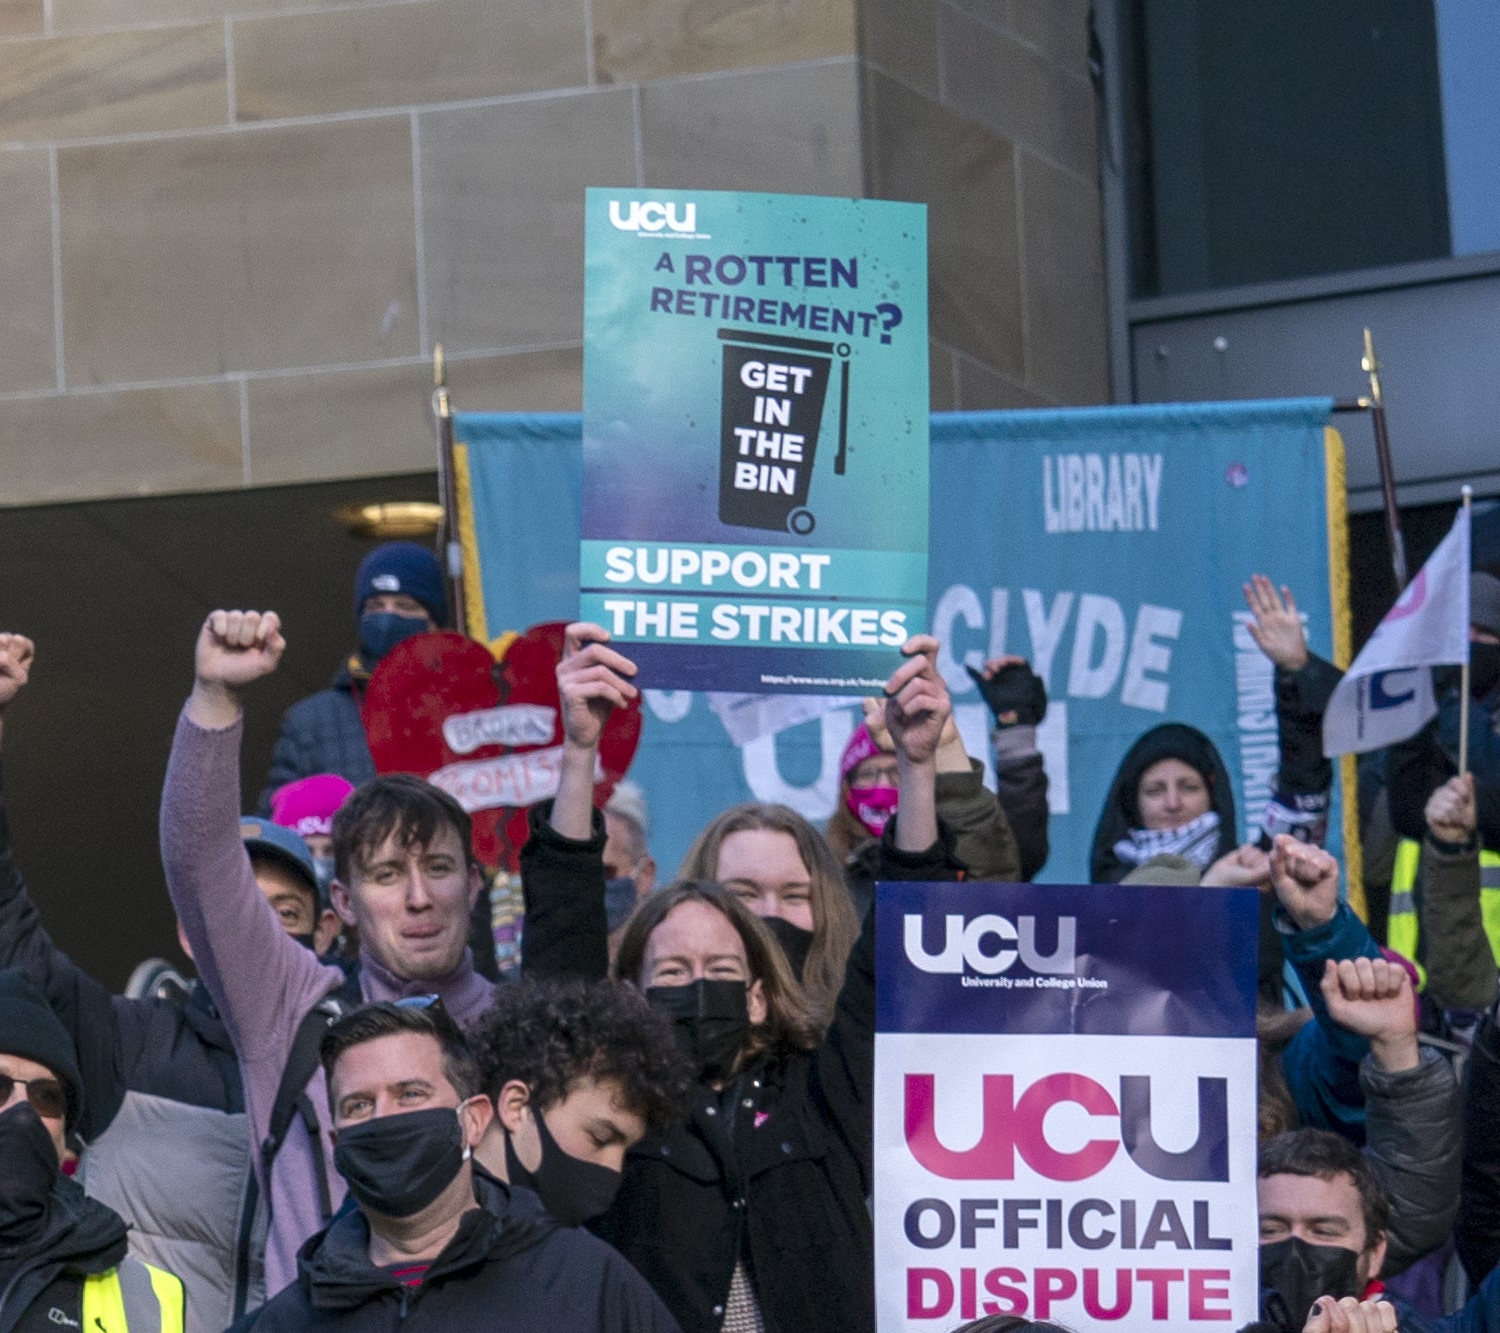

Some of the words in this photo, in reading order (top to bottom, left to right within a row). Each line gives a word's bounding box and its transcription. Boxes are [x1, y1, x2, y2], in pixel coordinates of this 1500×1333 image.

[609, 200, 696, 232] UCU
[654, 252, 675, 273] A
[685, 254, 859, 289] ROTTEN
[650, 286, 903, 344] RETIREMENT?
[740, 360, 812, 394] GET
[753, 397, 791, 427] IN
[734, 427, 805, 462] THE
[734, 462, 796, 496] BIN
[1043, 453, 1163, 534] LIBRARY
[604, 546, 832, 591] SUPPORT
[604, 600, 699, 639] THE
[711, 604, 908, 647] STRIKES
[903, 914, 1076, 974] UCU
[961, 976, 1014, 989] University
[1014, 977, 1034, 987] and
[1035, 978, 1075, 989] College
[1077, 977, 1108, 989] Union
[904, 1072, 1230, 1183] UCU
[904, 1198, 1233, 1251] OFFICIAL
[906, 1267, 1233, 1322] DISPUTE
